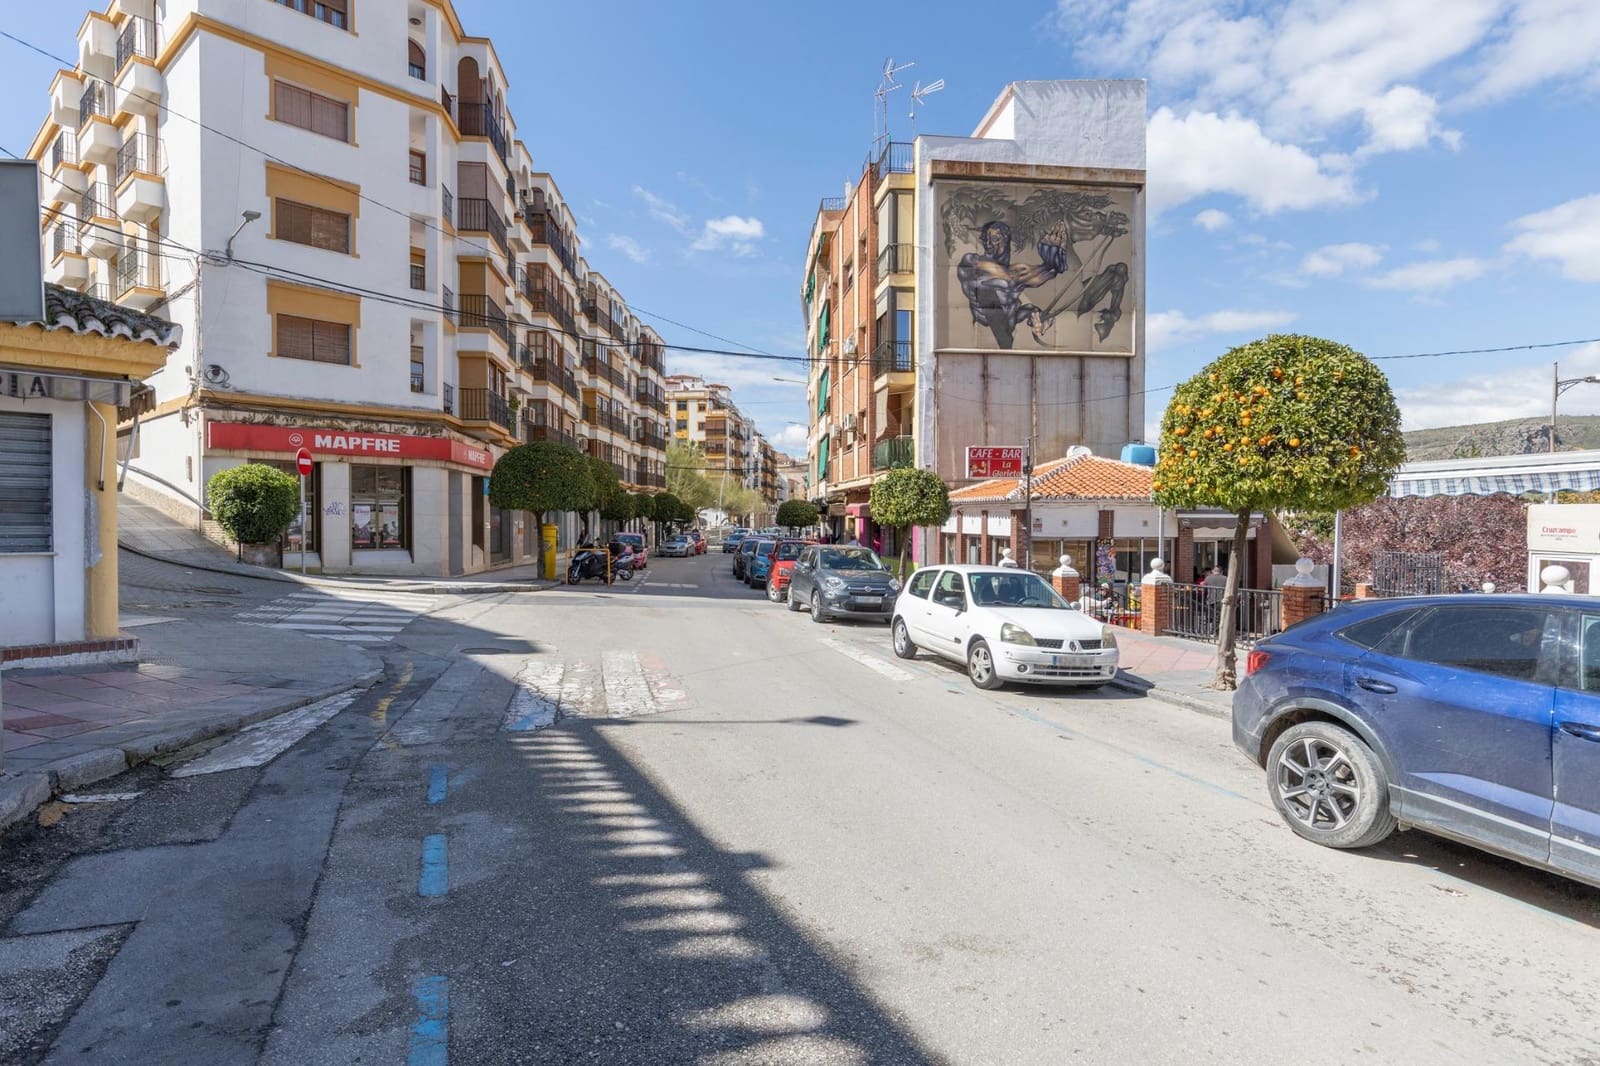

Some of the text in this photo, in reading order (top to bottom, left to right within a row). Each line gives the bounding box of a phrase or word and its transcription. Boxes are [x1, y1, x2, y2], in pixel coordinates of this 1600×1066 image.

[0, 374, 48, 397] IA
[315, 435, 400, 452] MAPFRE
[467, 450, 486, 464] MAPFRE
[1002, 449, 1021, 458] BAR
